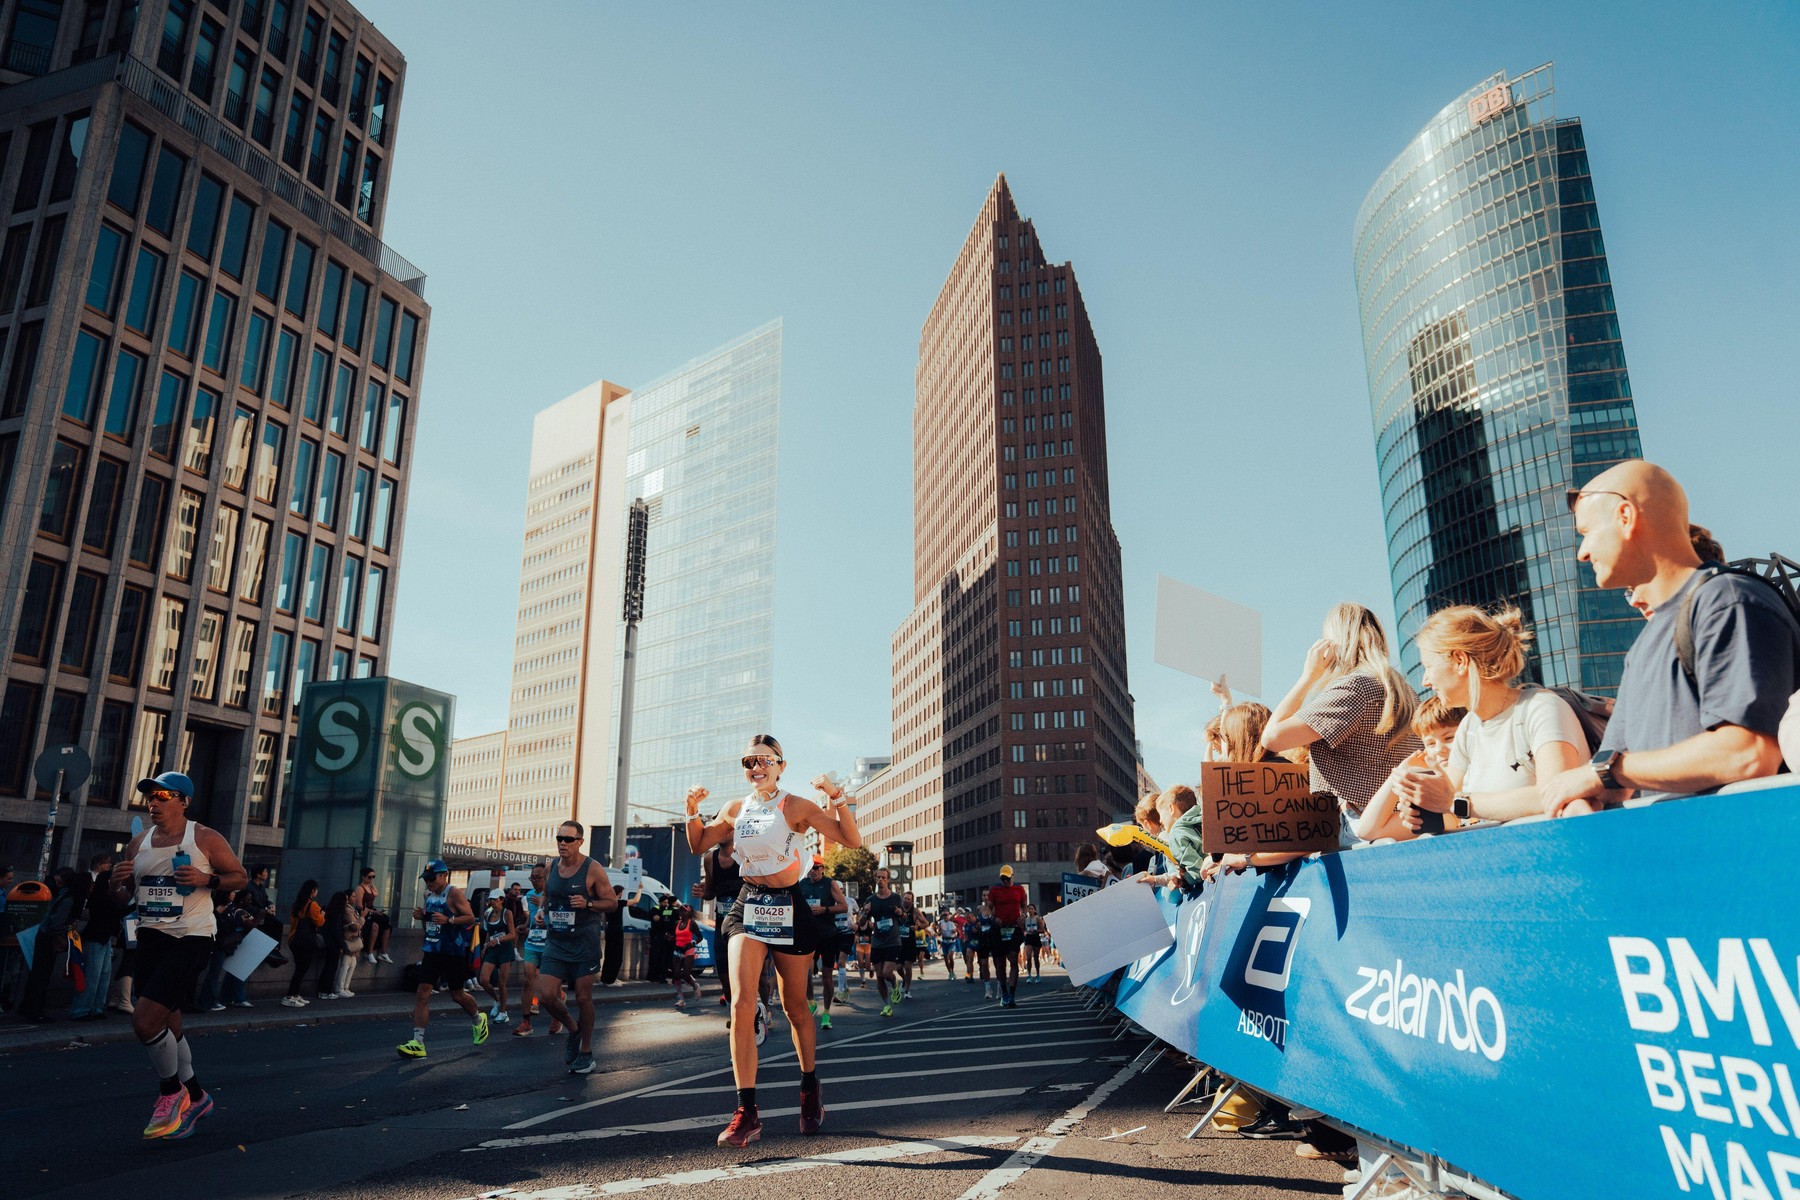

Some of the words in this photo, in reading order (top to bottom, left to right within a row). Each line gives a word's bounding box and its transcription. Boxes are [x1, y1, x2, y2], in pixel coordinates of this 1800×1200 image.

[1470, 86, 1505, 117] DB
[315, 701, 360, 771] S
[398, 707, 437, 776] S
[1213, 766, 1255, 796] THE
[1263, 766, 1310, 795] DATIN
[1216, 799, 1268, 820] POOL
[1273, 796, 1337, 815] CANNOT
[1223, 825, 1249, 844] BE
[1251, 821, 1292, 841] THIS
[486, 850, 538, 863] POTSDAMER
[148, 888, 173, 897] 81315
[1065, 883, 1087, 898] Let's
[754, 906, 784, 916] 60428
[1345, 958, 1507, 1062] zalando
[1237, 1008, 1290, 1046] ABBOTT
